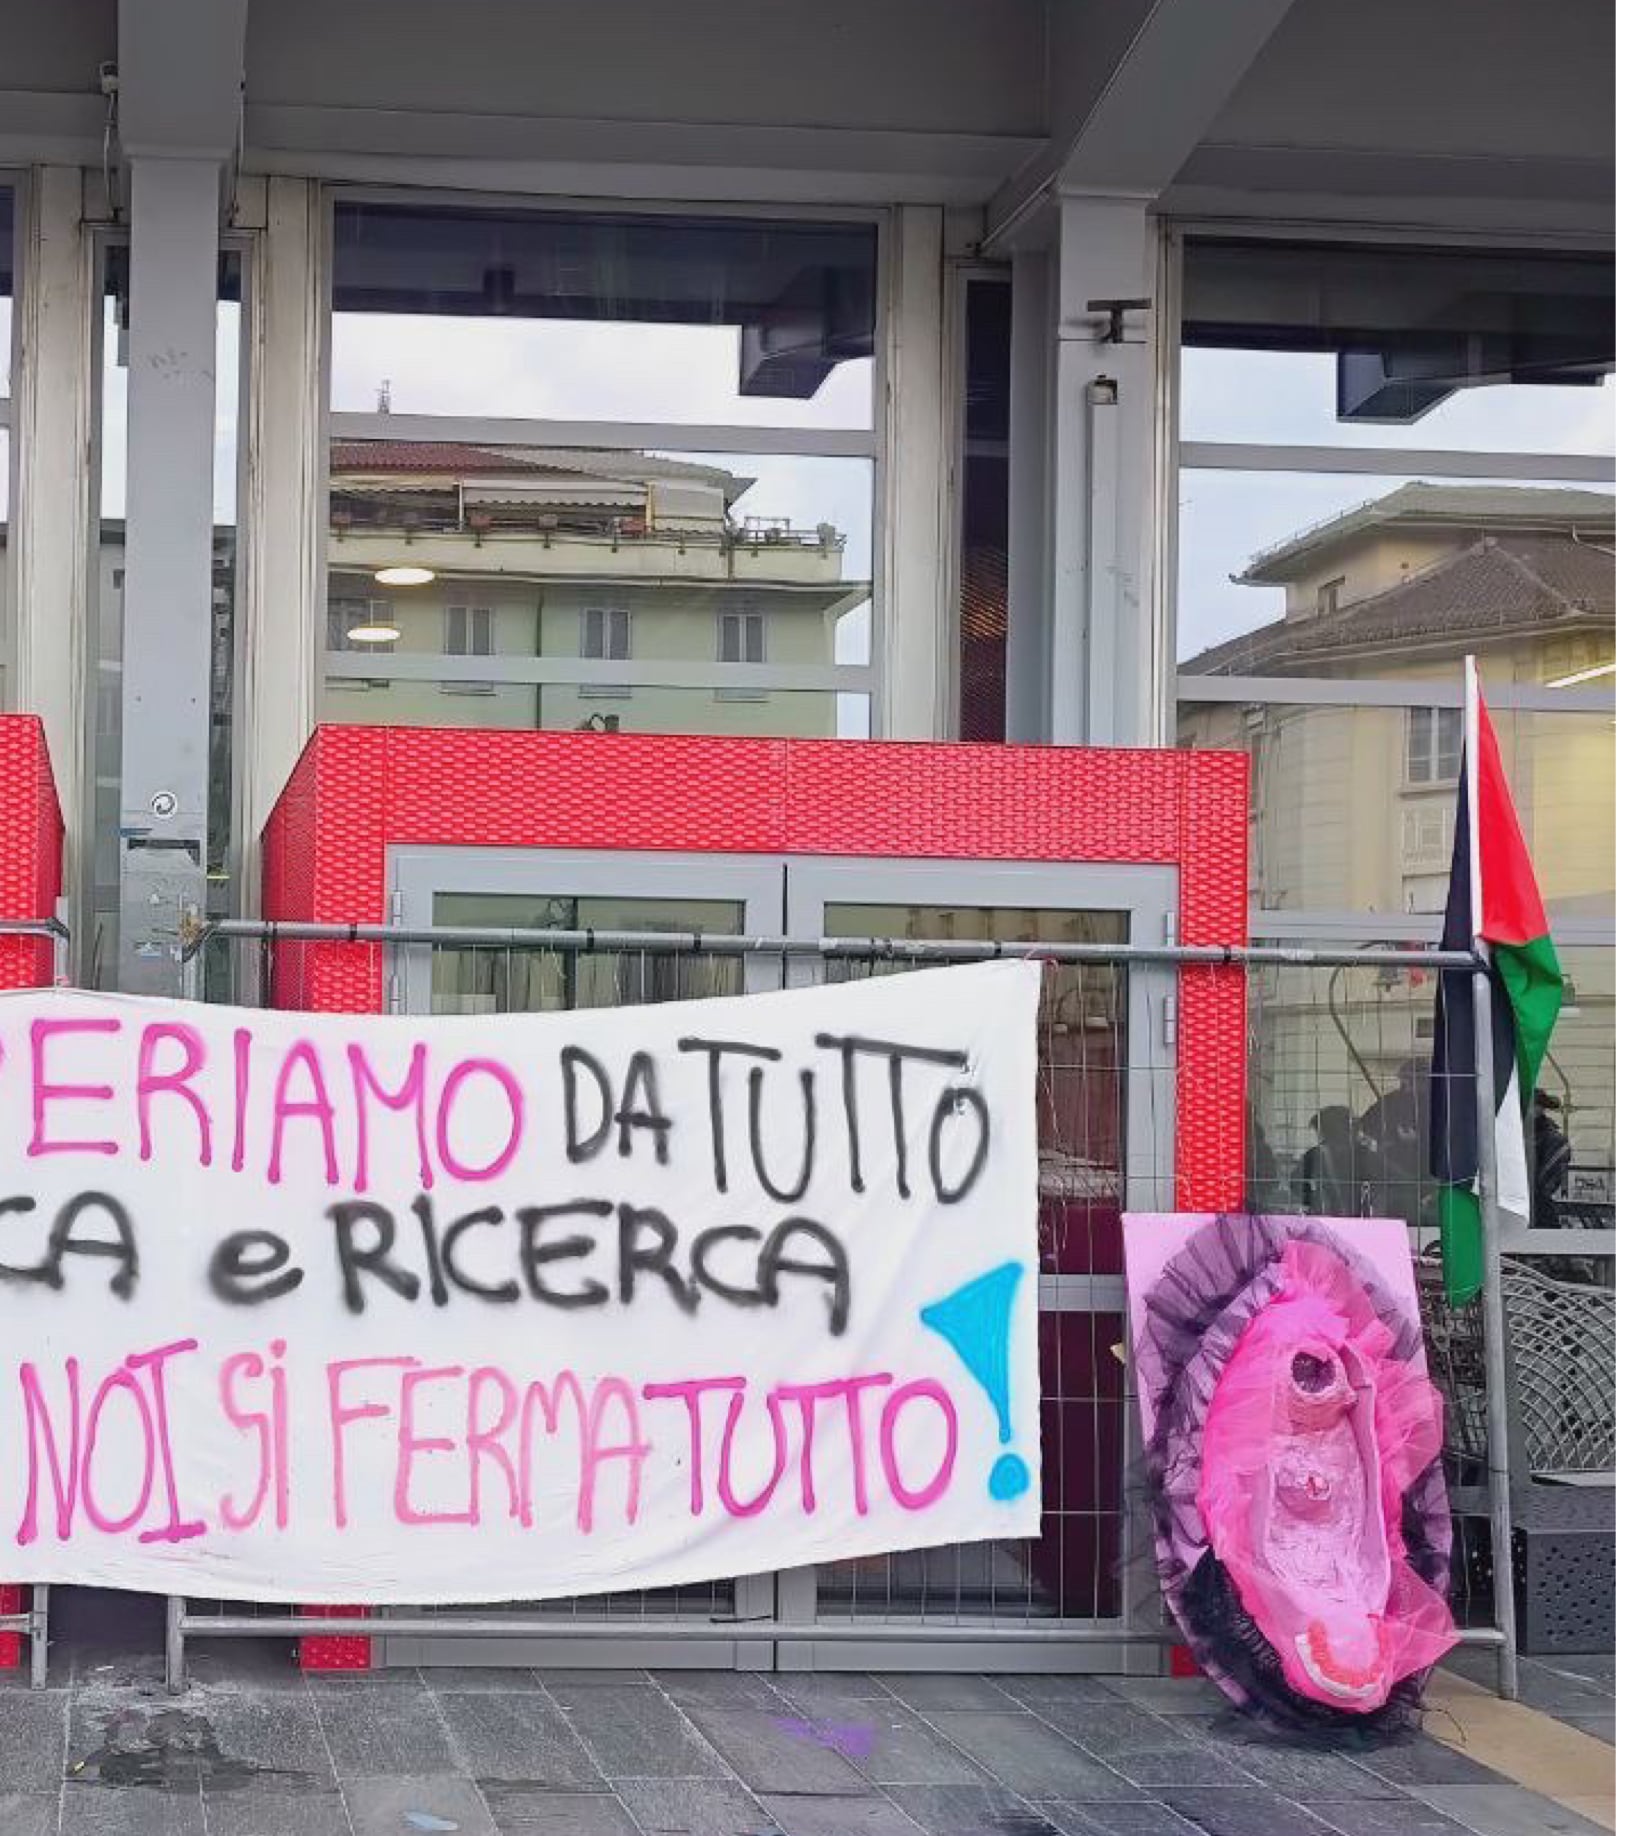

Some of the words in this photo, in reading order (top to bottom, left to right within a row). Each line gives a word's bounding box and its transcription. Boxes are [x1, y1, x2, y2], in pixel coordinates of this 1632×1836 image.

[0, 1016, 526, 1196] ERIAMO
[560, 1045, 674, 1167] DA
[677, 1032, 991, 1206] TUTTO
[326, 1194, 850, 1337] RICERCA
[13, 1338, 210, 1548] NOI
[326, 1356, 650, 1536] FERMA
